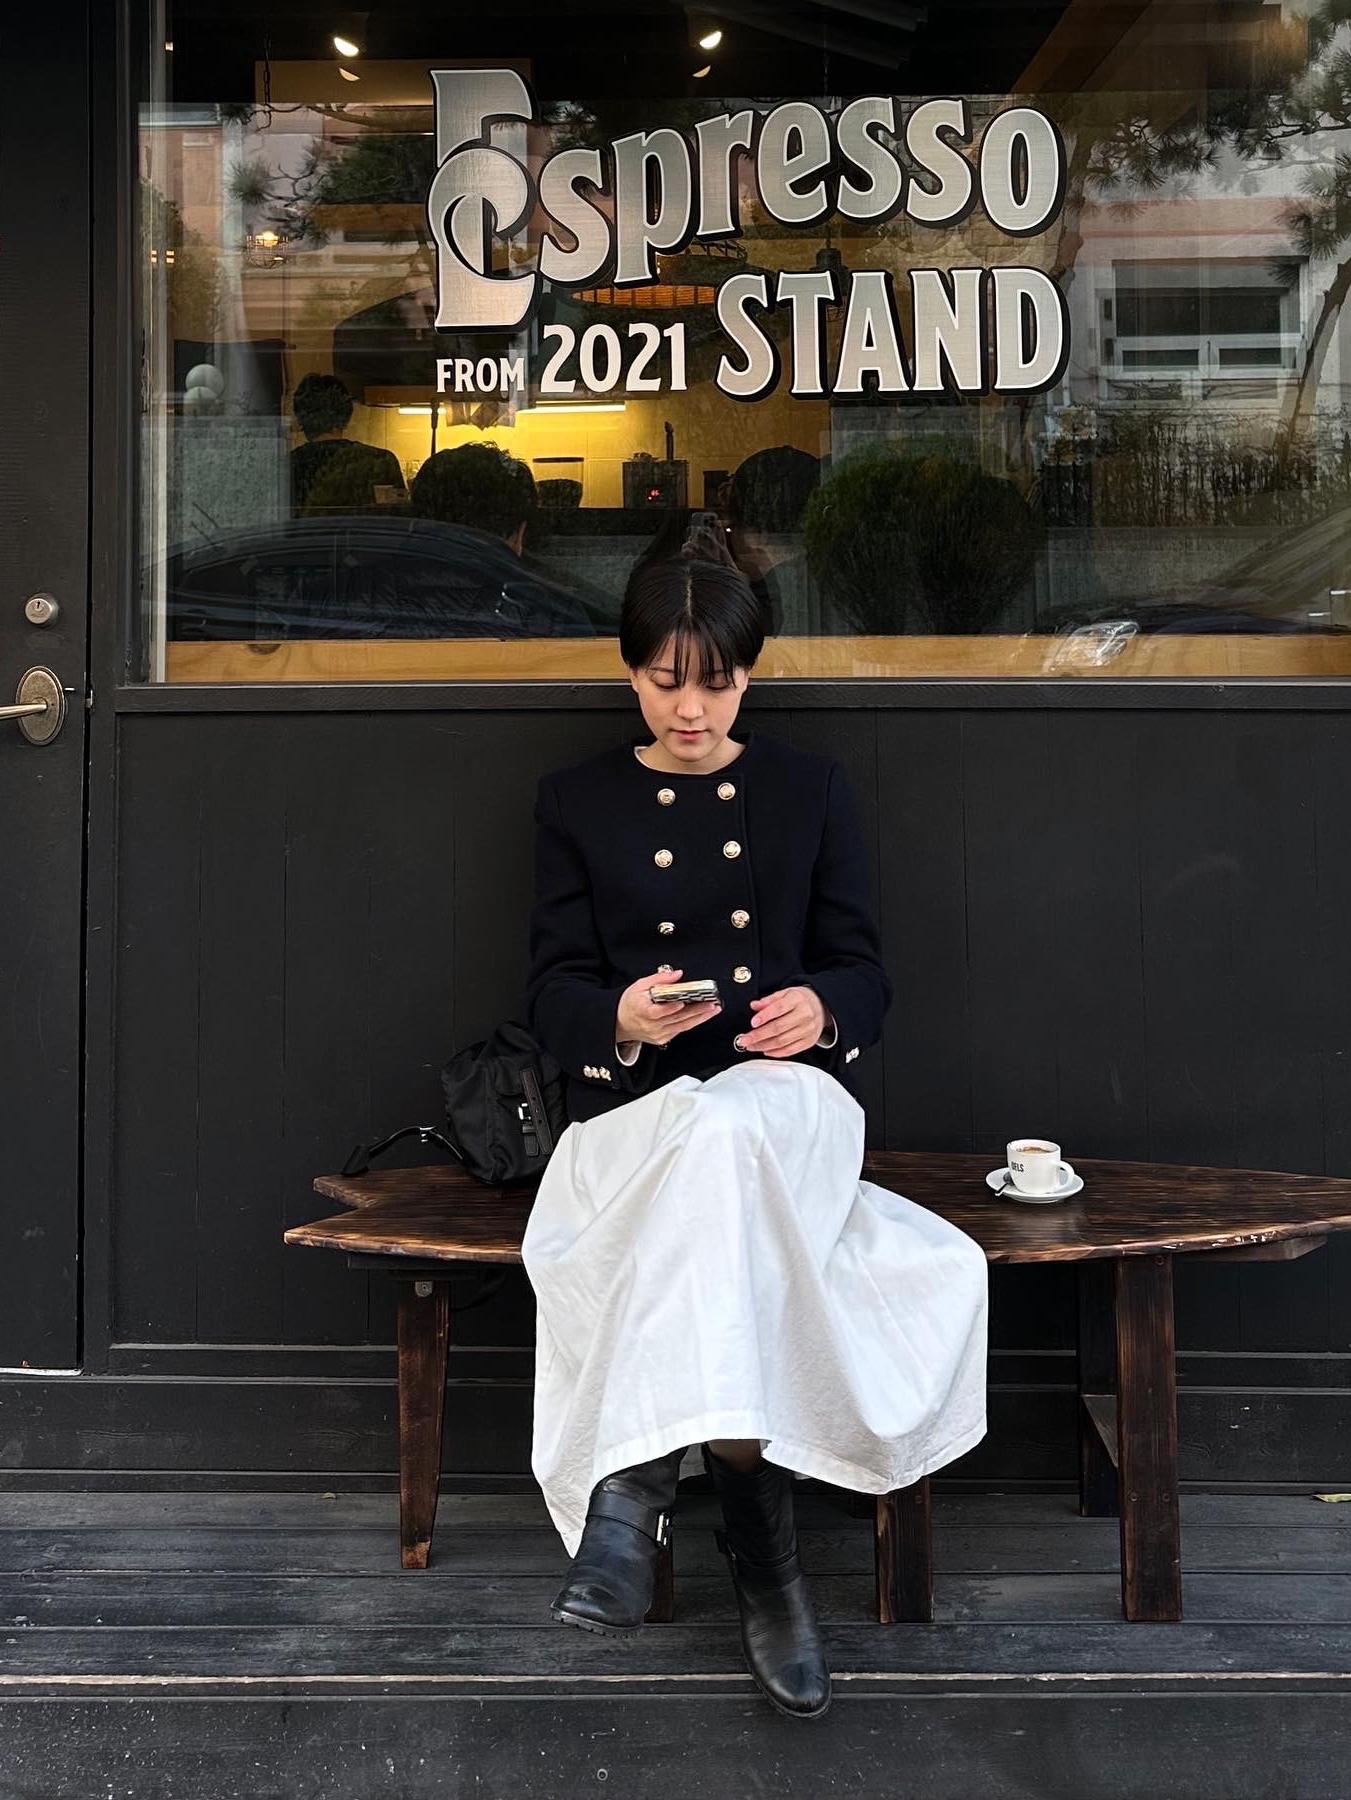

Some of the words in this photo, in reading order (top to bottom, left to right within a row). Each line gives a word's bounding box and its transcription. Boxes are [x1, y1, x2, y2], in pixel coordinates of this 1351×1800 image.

[428, 69, 1064, 330] Espresso
[436, 357, 525, 393] FROM
[540, 322, 687, 393] 2021
[716, 267, 1069, 398] STAND
